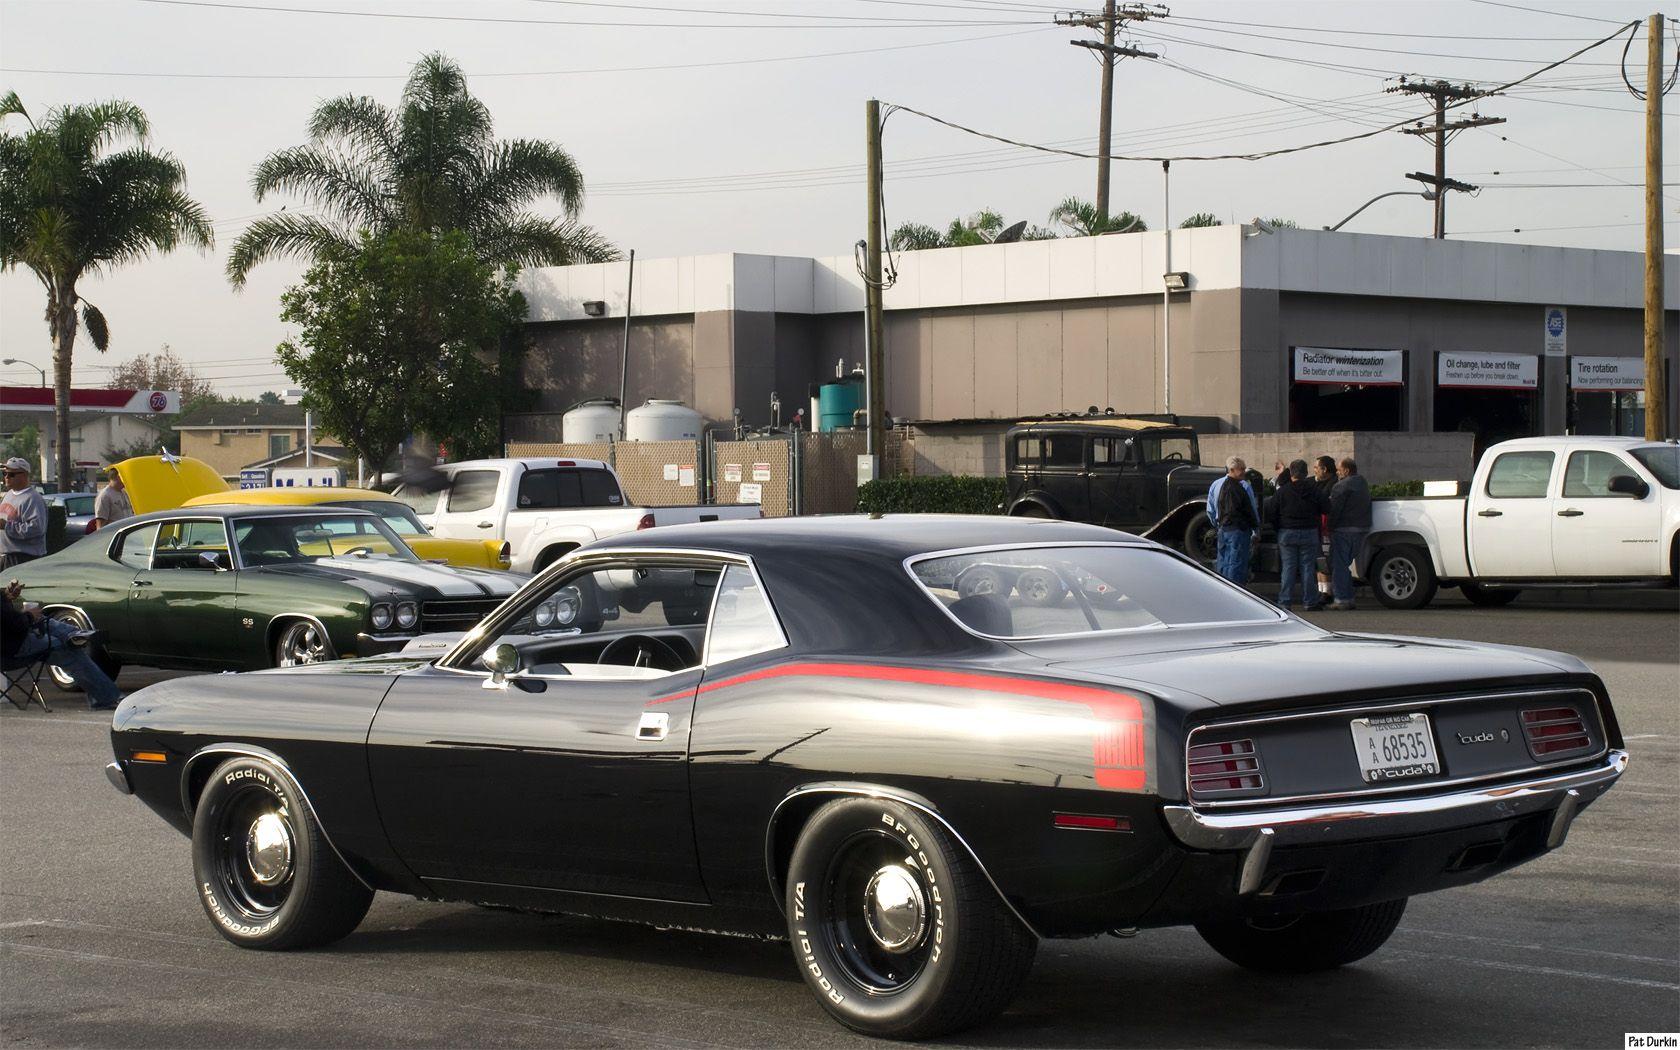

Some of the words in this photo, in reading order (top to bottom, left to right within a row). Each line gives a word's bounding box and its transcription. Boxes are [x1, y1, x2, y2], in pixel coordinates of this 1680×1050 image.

[1304, 353, 1334, 364] Radiator
[1336, 355, 1384, 366] winterization
[1446, 359, 1455, 368] Oil
[1456, 360, 1479, 370] change,
[1481, 360, 1493, 369] lube
[1495, 361, 1506, 370] and
[1507, 362, 1520, 370] filter
[1578, 362, 1590, 372] Tire
[1592, 364, 1618, 373] rotation
[1303, 367, 1310, 375] Be
[1312, 368, 1327, 376] better
[1328, 368, 1336, 376] off
[1578, 376, 1588, 384] Now
[1589, 377, 1613, 386] performing
[1369, 737, 1376, 749] A
[1383, 732, 1426, 762] 68535
[1373, 752, 1379, 764] A
[226, 768, 270, 784] Radial
[274, 782, 289, 809] T/A
[882, 813, 944, 963] BFGoodrich
[204, 882, 280, 936] BFGoodrich
[796, 882, 806, 920] T/A
[798, 930, 845, 1005] Radial
